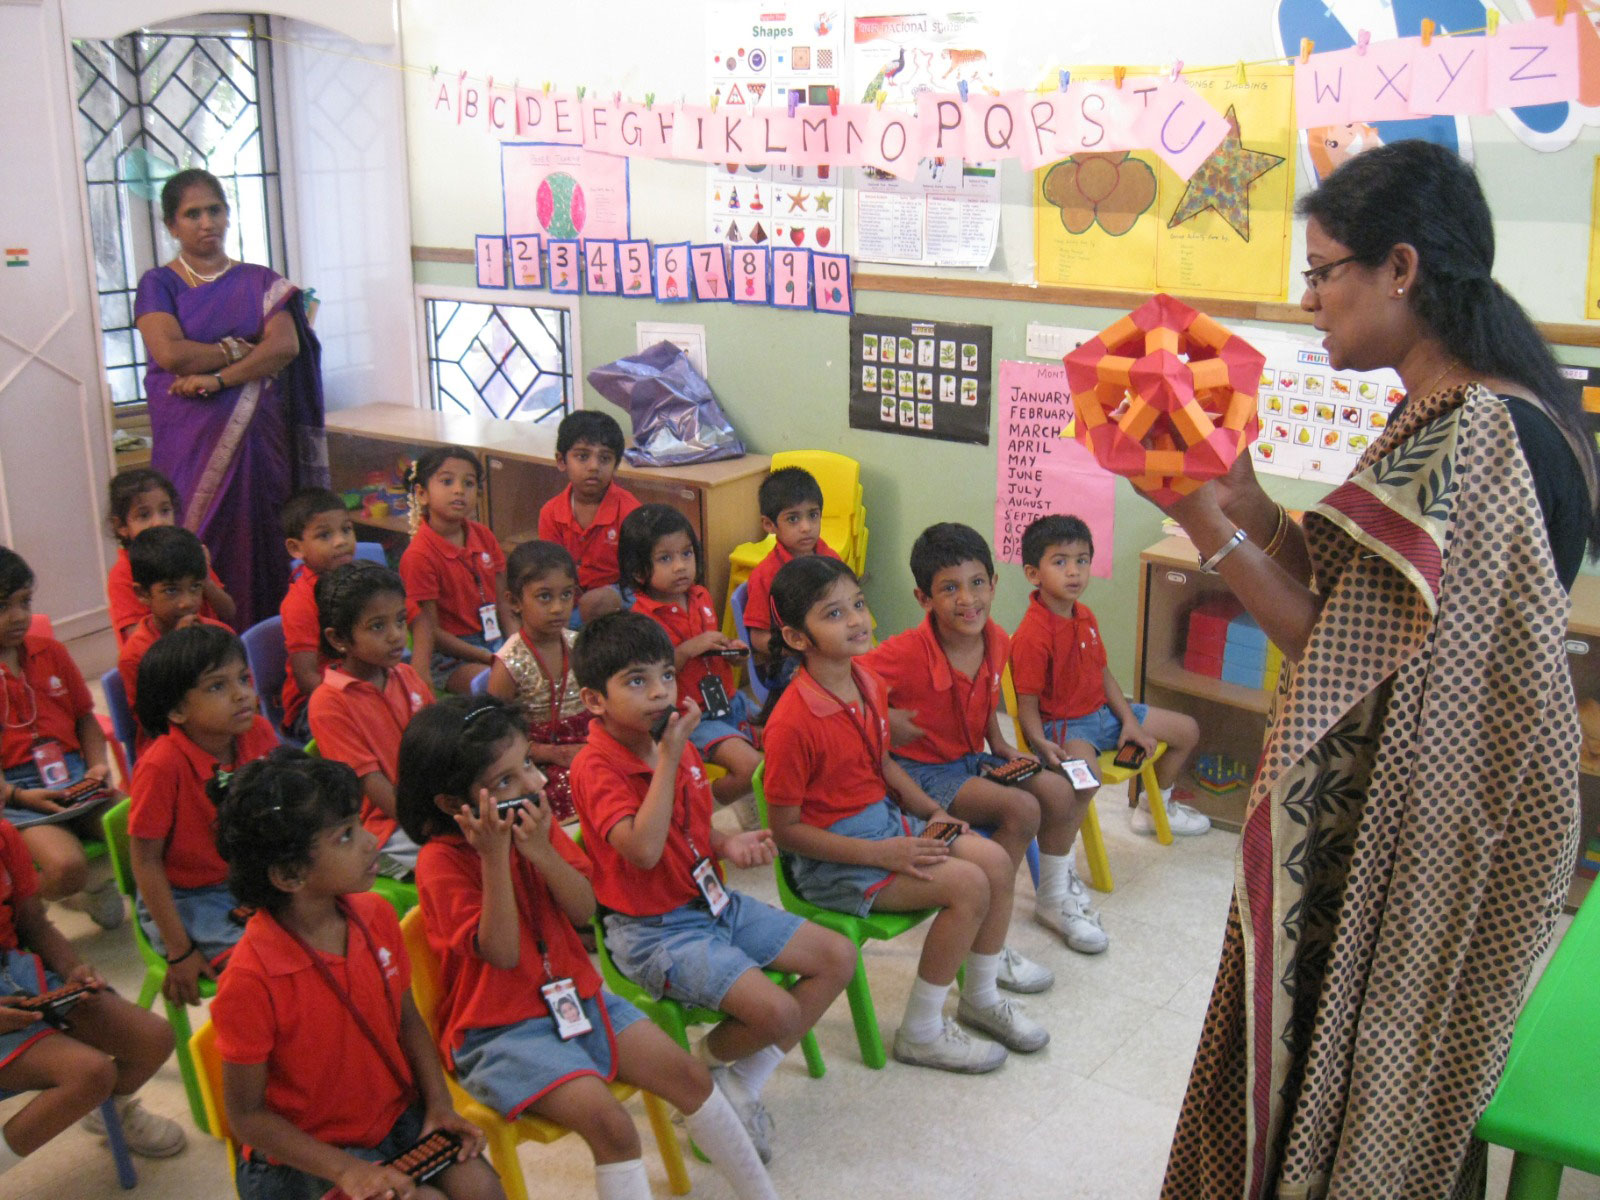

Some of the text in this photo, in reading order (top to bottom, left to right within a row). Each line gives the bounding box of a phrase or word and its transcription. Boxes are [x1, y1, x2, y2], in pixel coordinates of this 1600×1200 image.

[752, 25, 794, 39] Shapes
[1314, 46, 1557, 103] W X Y Z
[435, 83, 451, 110] A
[465, 89, 479, 118] B
[492, 96, 506, 129] C
[526, 96, 542, 126] D
[555, 99, 572, 132] E
[593, 108, 607, 139] F
[621, 111, 642, 146] G
[697, 118, 703, 149] I
[726, 116, 743, 153] K
[765, 118, 787, 152] L
[803, 118, 829, 152] M
[881, 121, 906, 162] O
[937, 100, 962, 148] P
[984, 103, 1014, 150] Q
[1031, 101, 1056, 155] R
[1081, 94, 1105, 147] S
[1133, 86, 1158, 107] T
[1161, 100, 1206, 154] U
[484, 241, 840, 282] 1 2 3 4 5 6 7 8 9 10
[1011, 386, 1071, 405] JANUARY
[1010, 406, 1074, 423] FEBRUARY
[1009, 423, 1061, 440] MARCH
[1007, 440, 1052, 454] APRIL
[1008, 454, 1036, 467] MAY
[1008, 467, 1042, 481] JUNE
[1008, 483, 1042, 498] JULY
[1008, 496, 1052, 510] AUGUST
[1004, 510, 1045, 521] SEPTE
